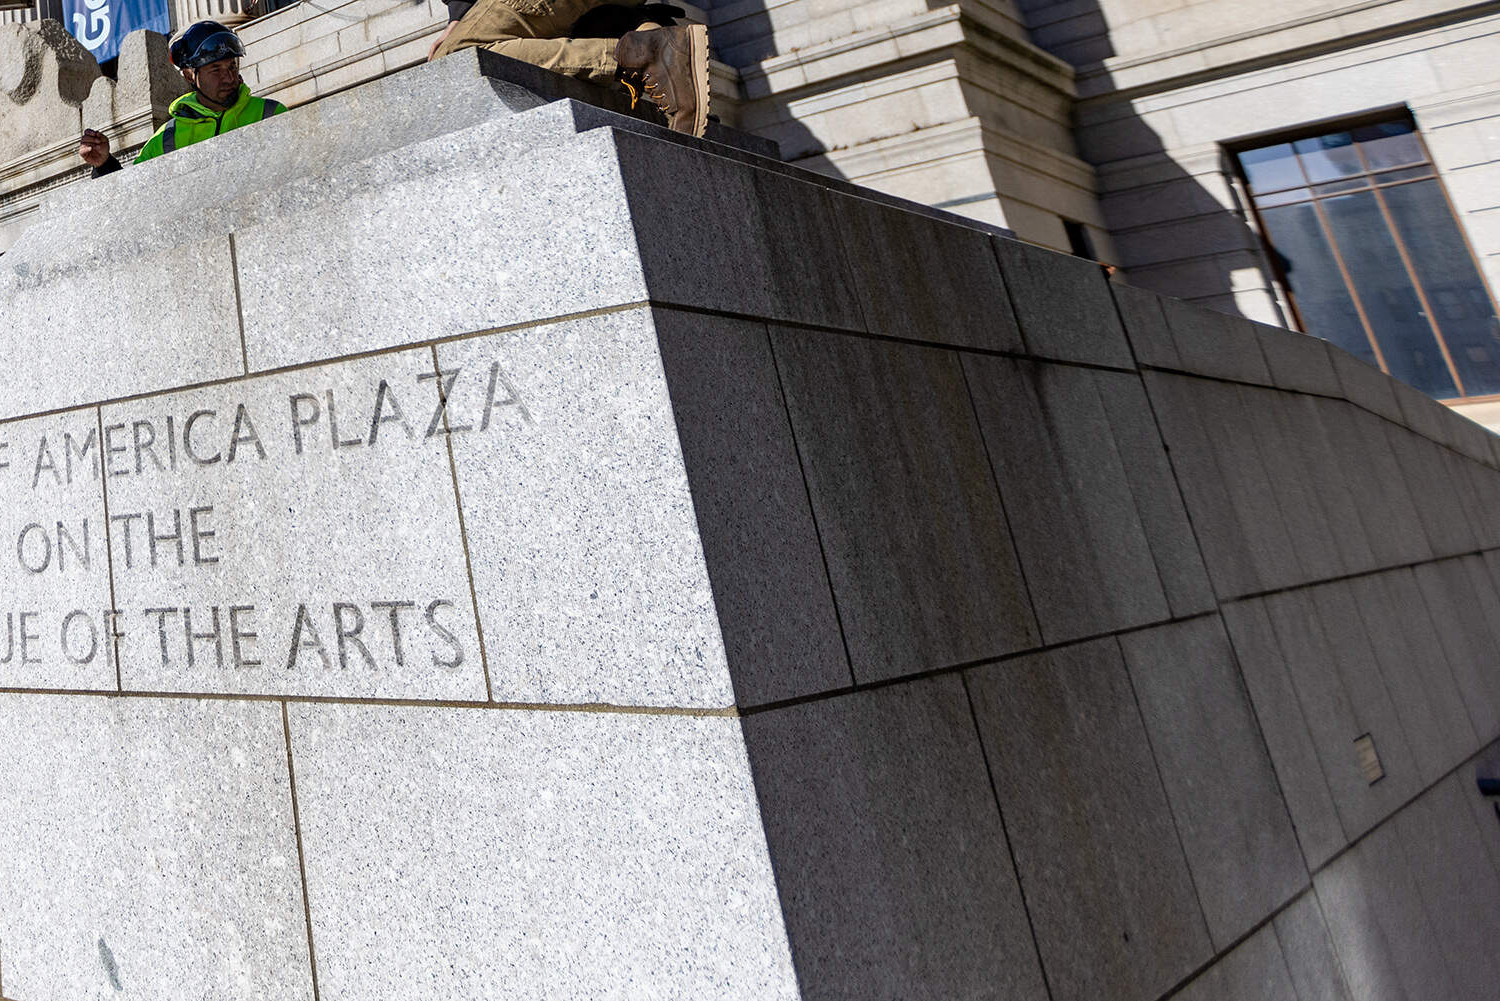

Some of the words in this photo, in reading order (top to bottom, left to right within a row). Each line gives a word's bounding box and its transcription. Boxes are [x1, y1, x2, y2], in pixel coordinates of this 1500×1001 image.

[32, 403, 268, 492] AMERICA
[290, 361, 534, 456] PLAZA
[16, 518, 91, 575] ON
[112, 506, 220, 571] THE
[60, 609, 121, 667] OF
[145, 604, 262, 669] THE
[286, 599, 465, 671] ARTS
